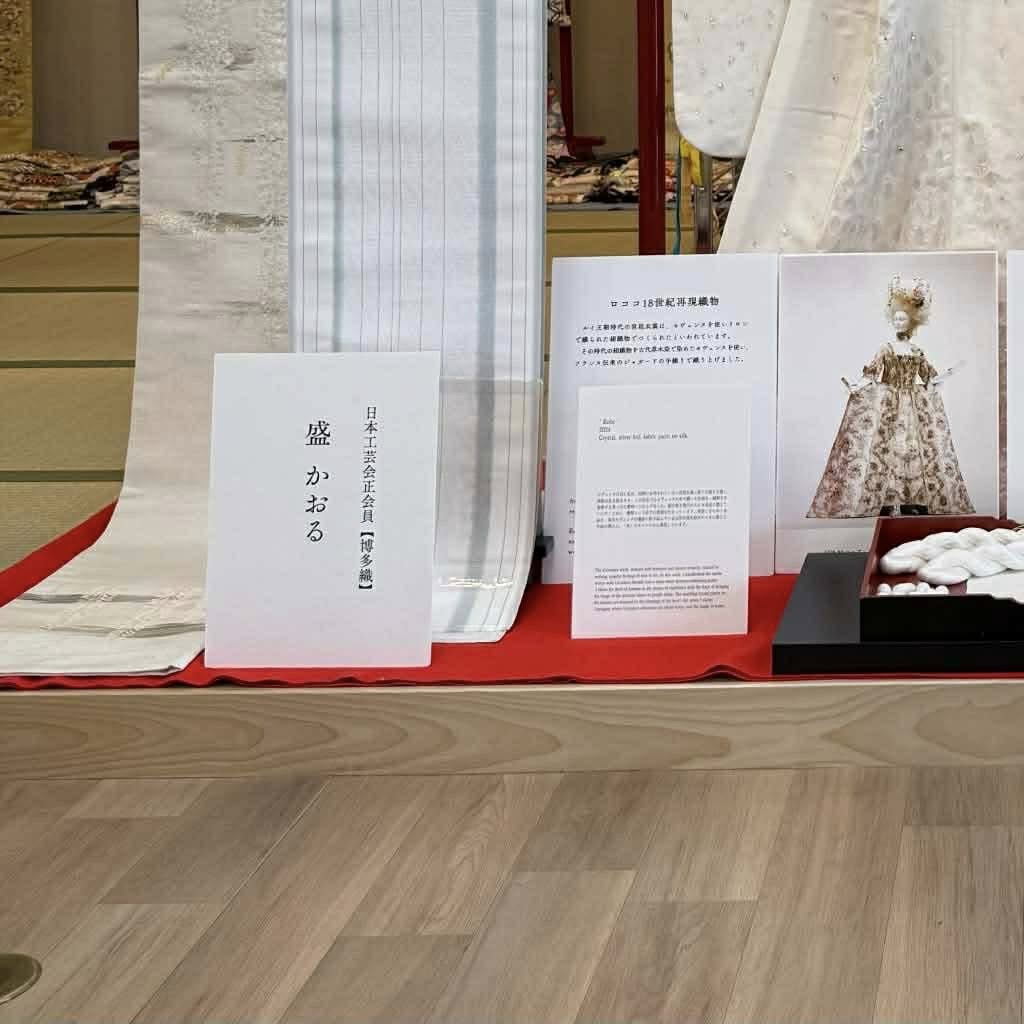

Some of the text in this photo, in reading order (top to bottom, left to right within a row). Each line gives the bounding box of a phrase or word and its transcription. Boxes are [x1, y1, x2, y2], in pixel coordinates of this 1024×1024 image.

[610, 296, 720, 308] ロココ18世紀再現織物
[305, 421, 331, 543] 盛 かおる
[359, 406, 378, 590] 日本工芸会正会員【博多織】
